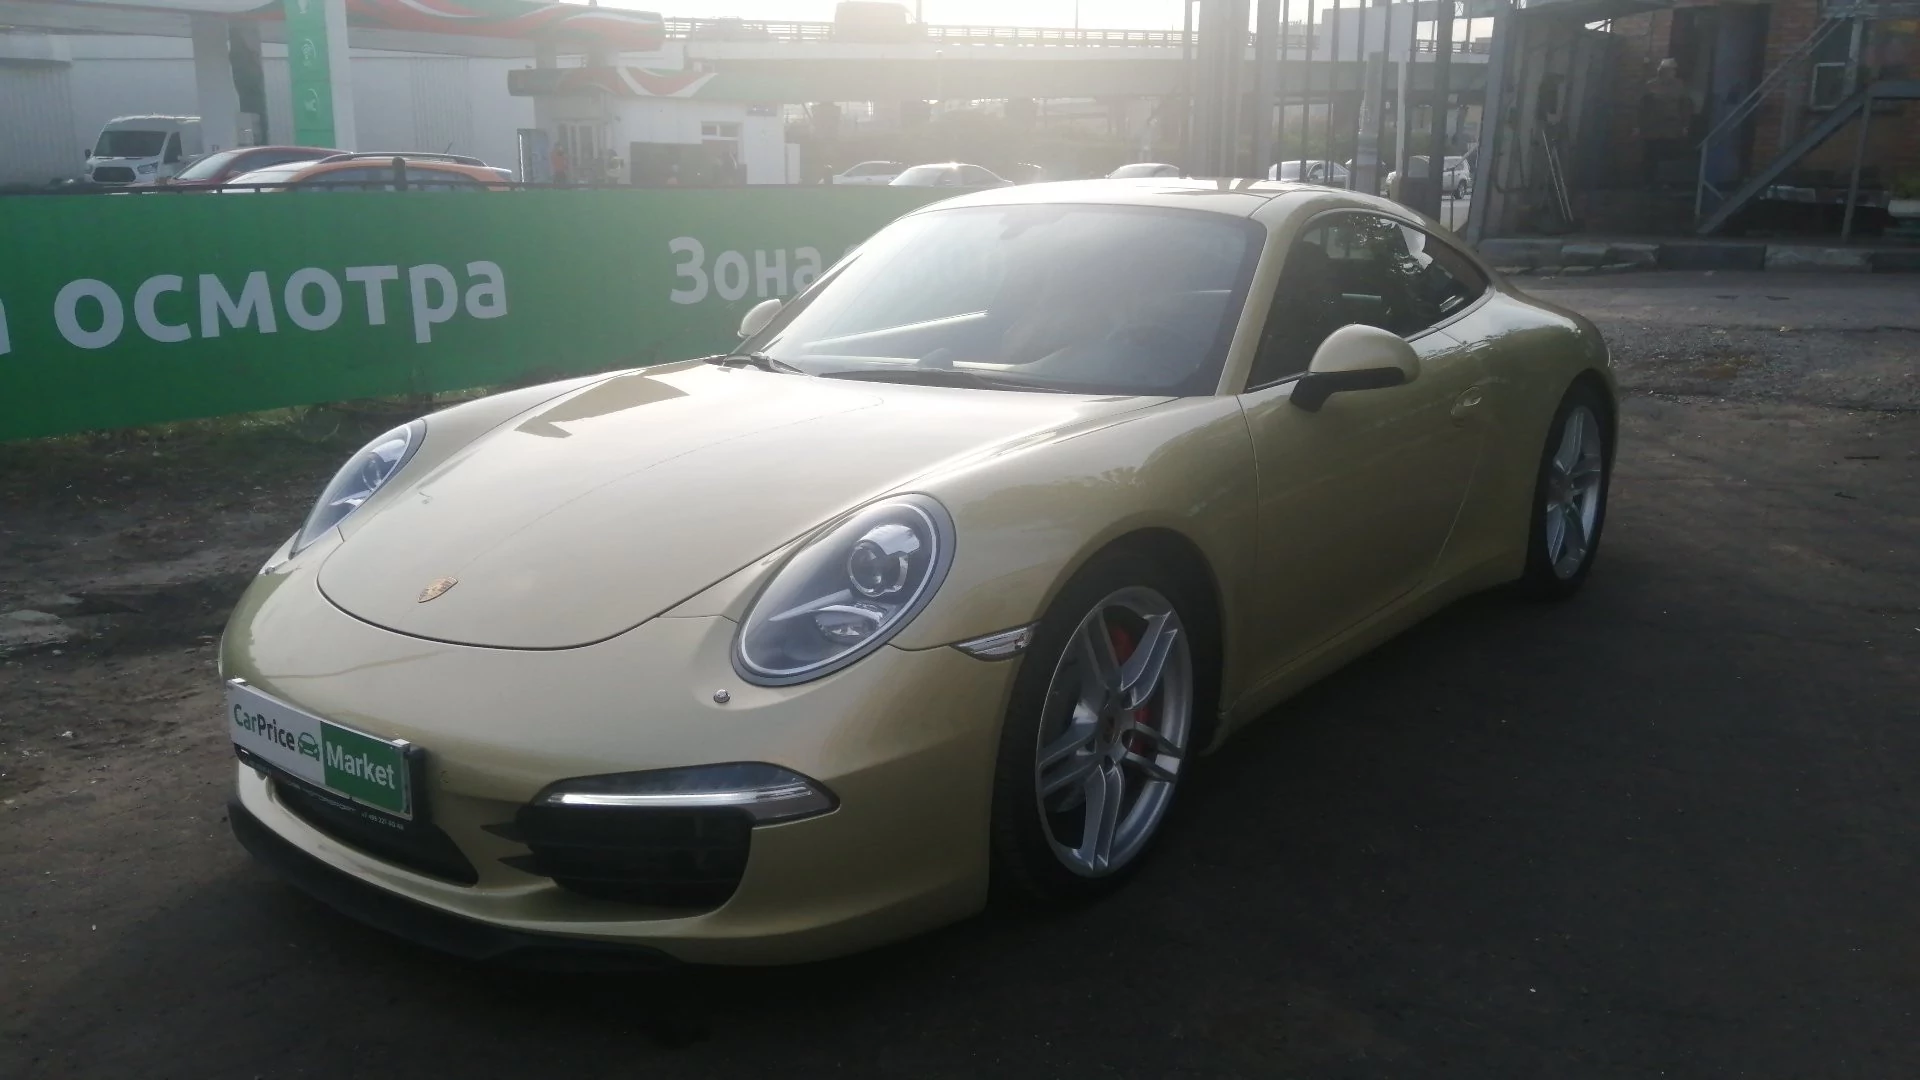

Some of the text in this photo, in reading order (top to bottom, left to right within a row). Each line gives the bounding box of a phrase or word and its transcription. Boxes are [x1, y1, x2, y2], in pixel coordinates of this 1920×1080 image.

[54, 260, 508, 349] осмотра
[668, 236, 821, 305] Зона
[233, 703, 395, 789] CarPrice Market
